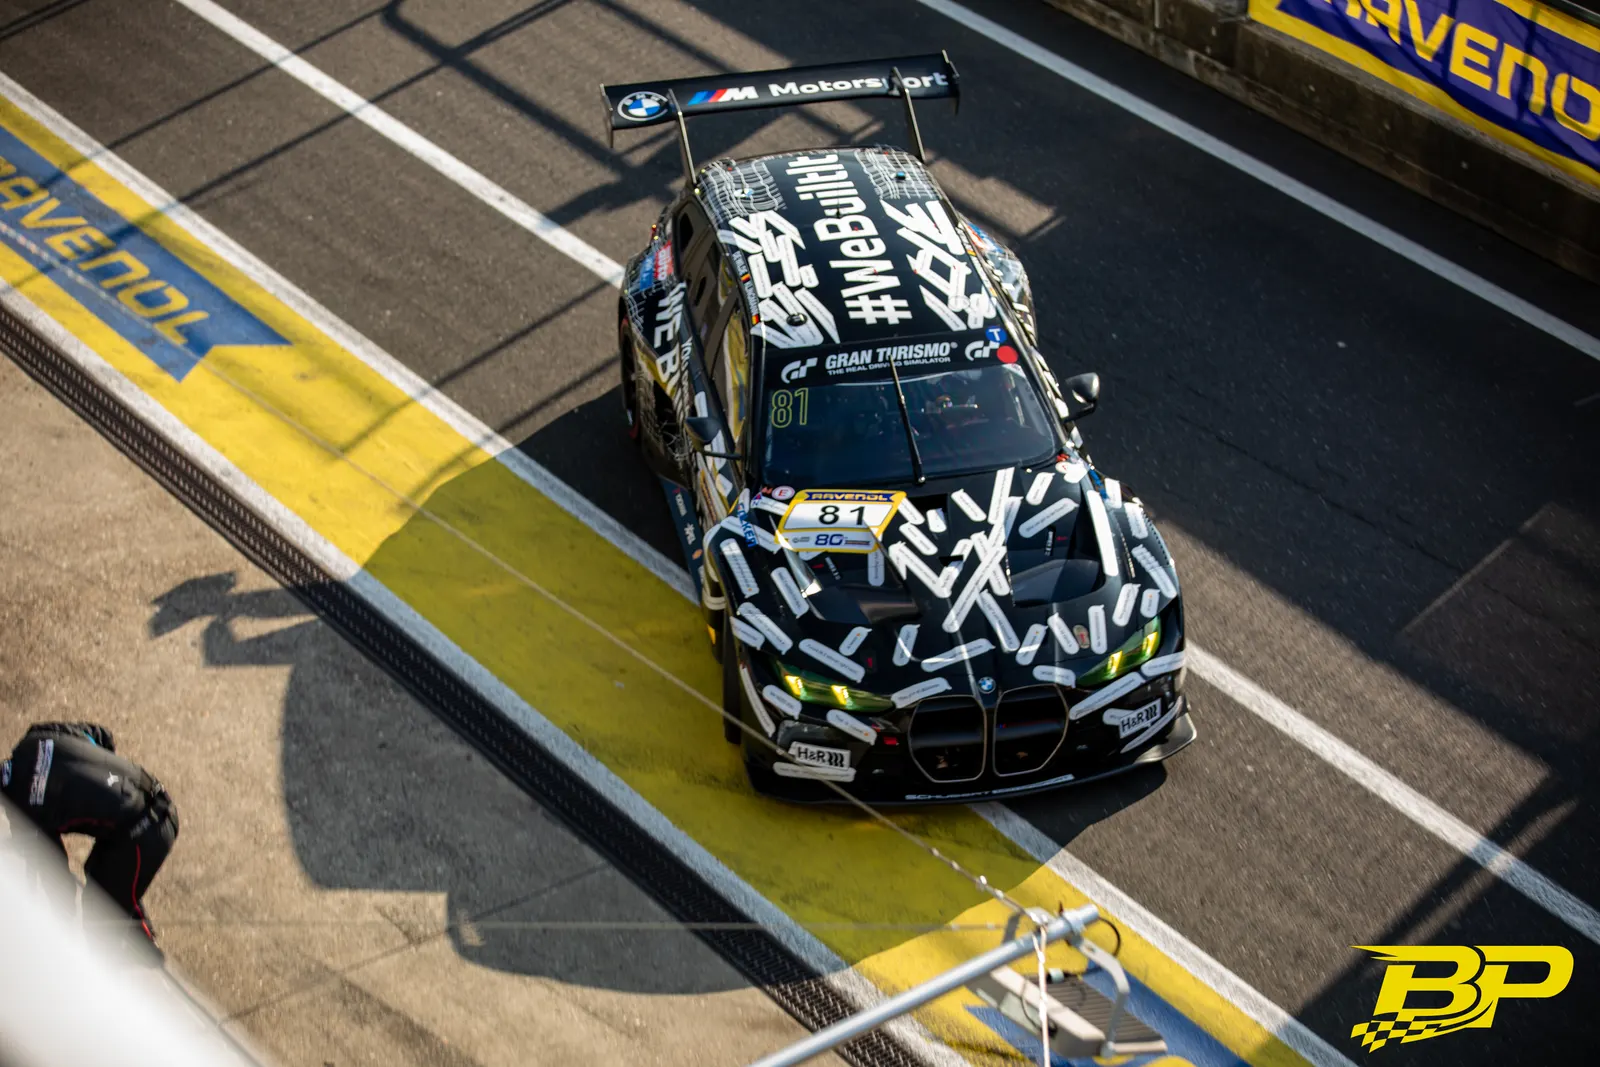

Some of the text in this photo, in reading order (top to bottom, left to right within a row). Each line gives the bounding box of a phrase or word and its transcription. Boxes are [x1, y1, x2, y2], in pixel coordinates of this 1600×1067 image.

[1325, 0, 1600, 141] AVENO
[768, 72, 948, 97] Motorsort
[989, 328, 1001, 342] T
[825, 350, 873, 370] GRAN
[845, 365, 868, 374] REAL
[903, 357, 951, 366] SIMULATOR
[770, 387, 809, 430] 81
[811, 493, 888, 501] RAVENOL
[818, 504, 866, 526] 81
